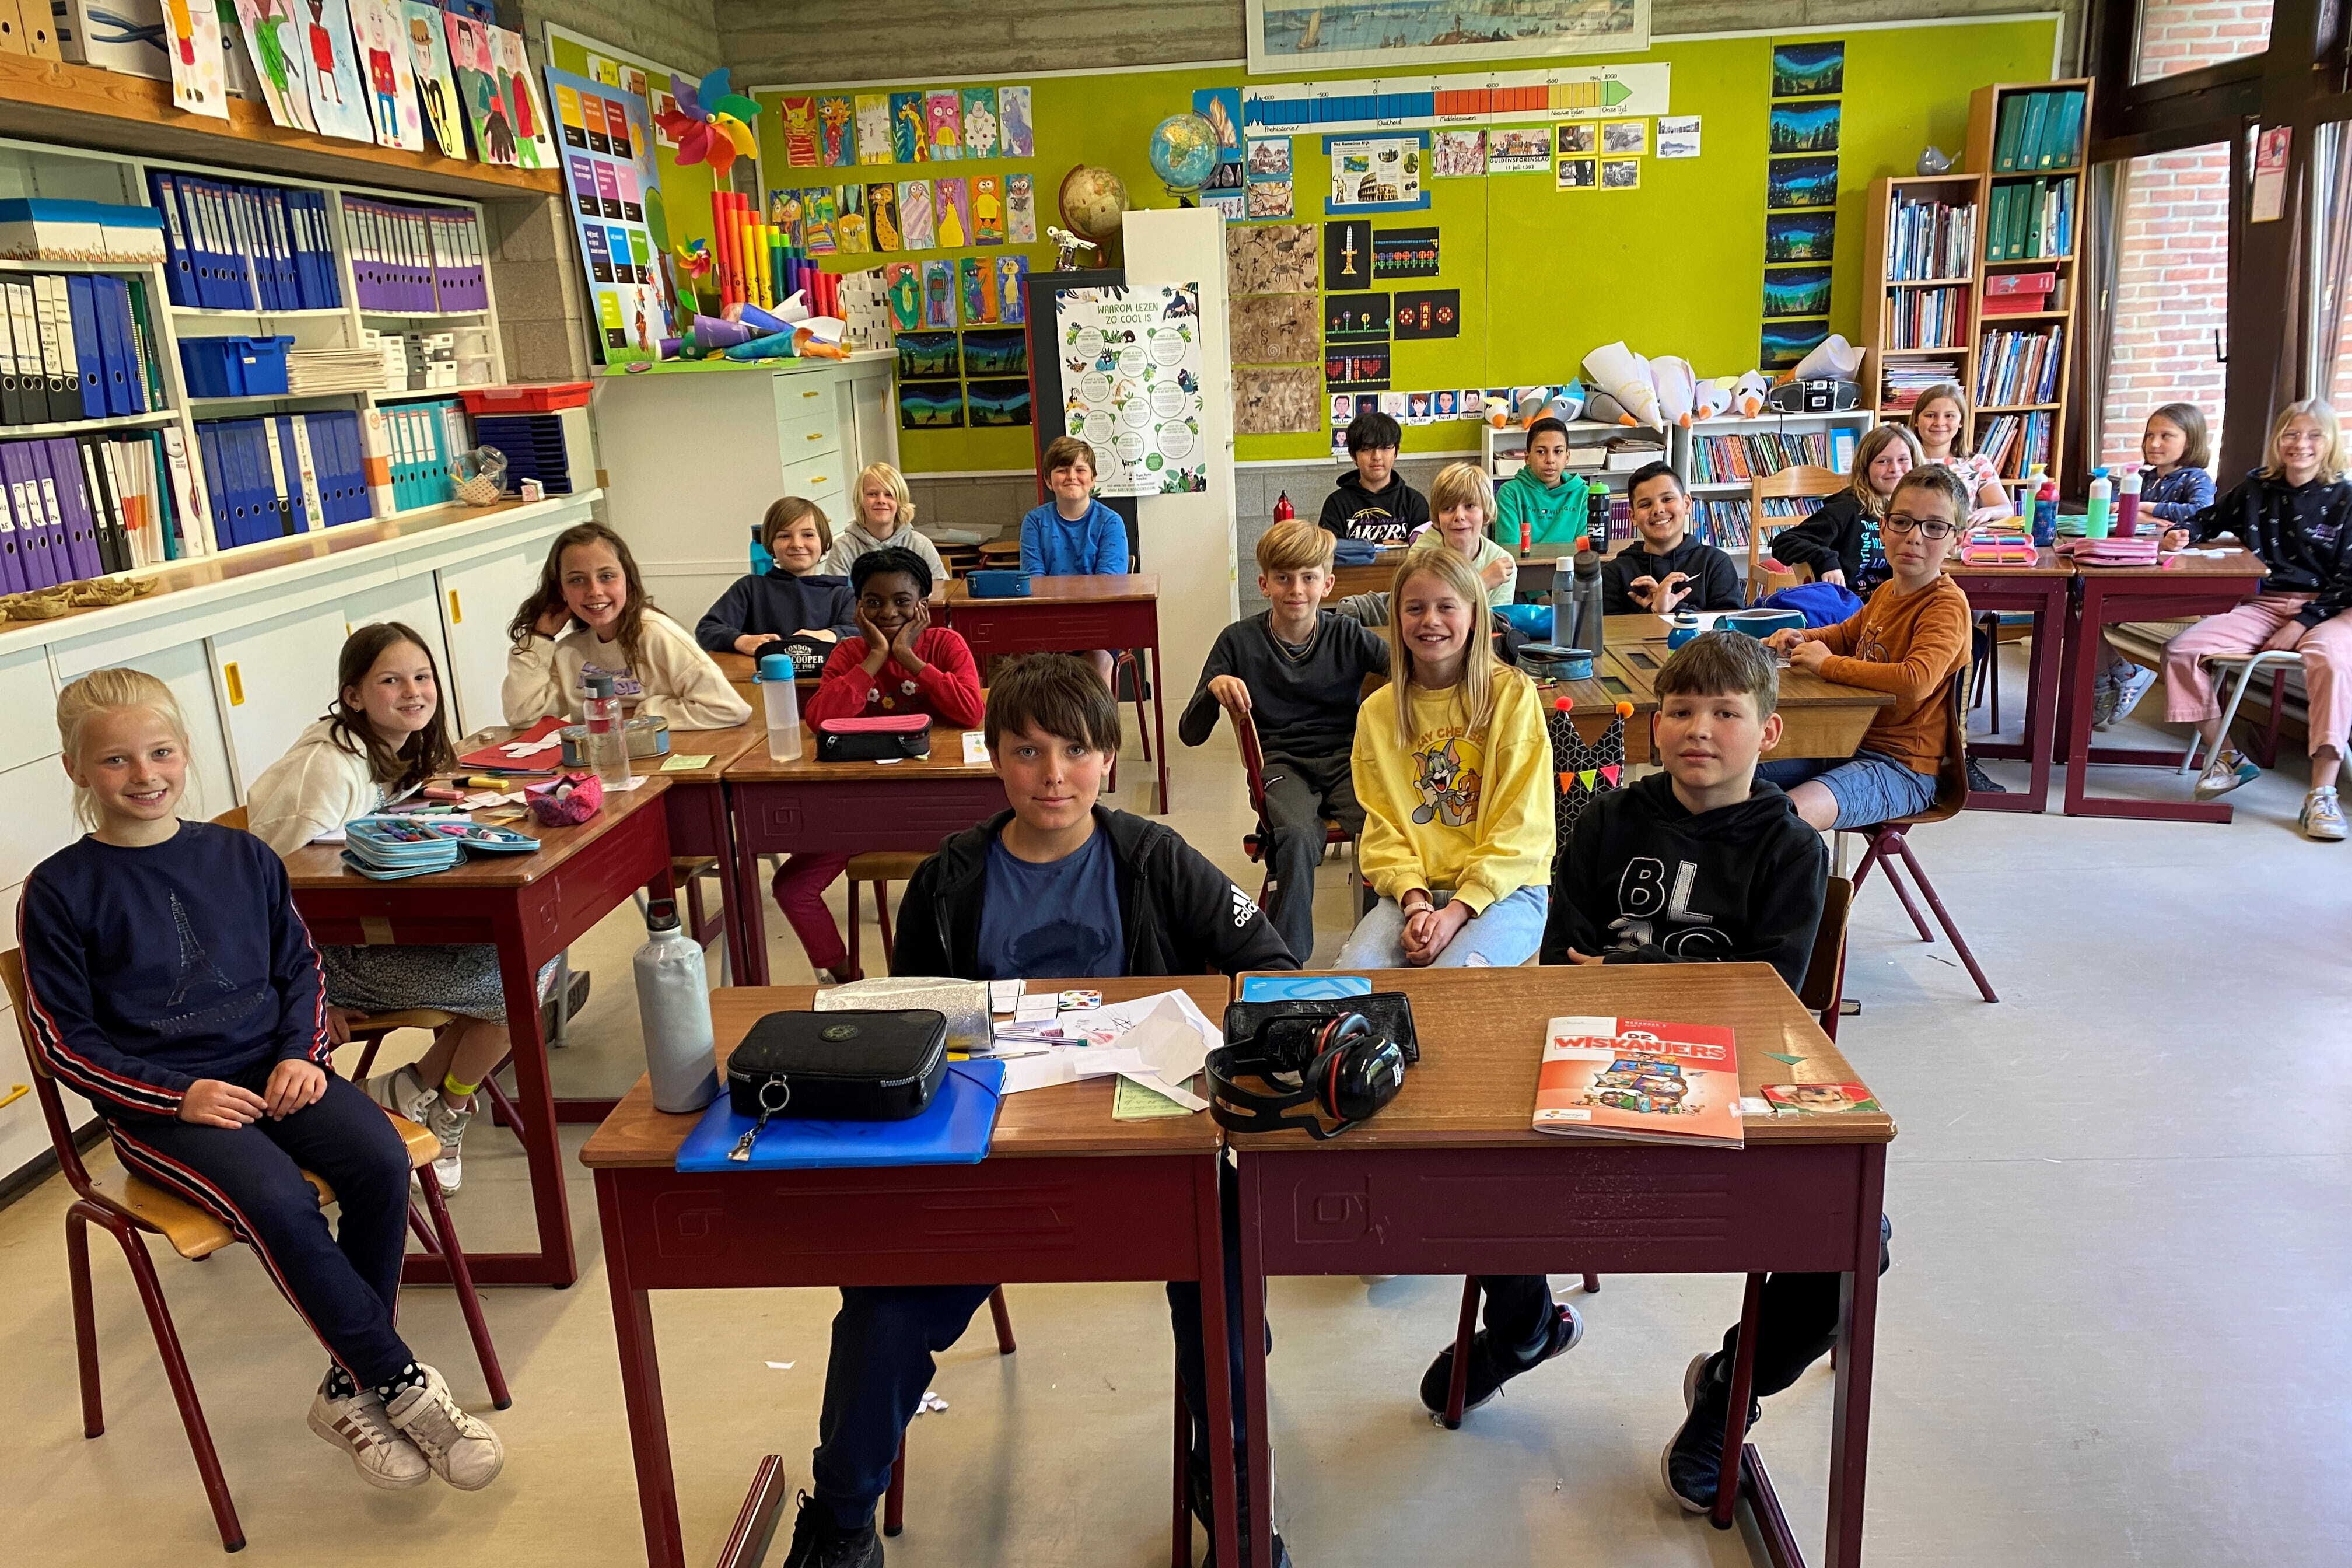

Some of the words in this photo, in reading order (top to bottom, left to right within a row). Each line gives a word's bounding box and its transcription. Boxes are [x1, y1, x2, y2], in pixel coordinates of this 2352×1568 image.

[1097, 304, 1132, 314] WAAROM
[1135, 302, 1158, 312] LEZEN
[1105, 316, 1117, 324] ZO
[1121, 314, 1142, 323] COOL
[1144, 313, 1152, 323] IS
[1861, 520, 1880, 531] THE
[783, 644, 813, 654] LONDON
[791, 654, 824, 664] COOPER
[1556, 1037, 1726, 1059] WISKANJERS
